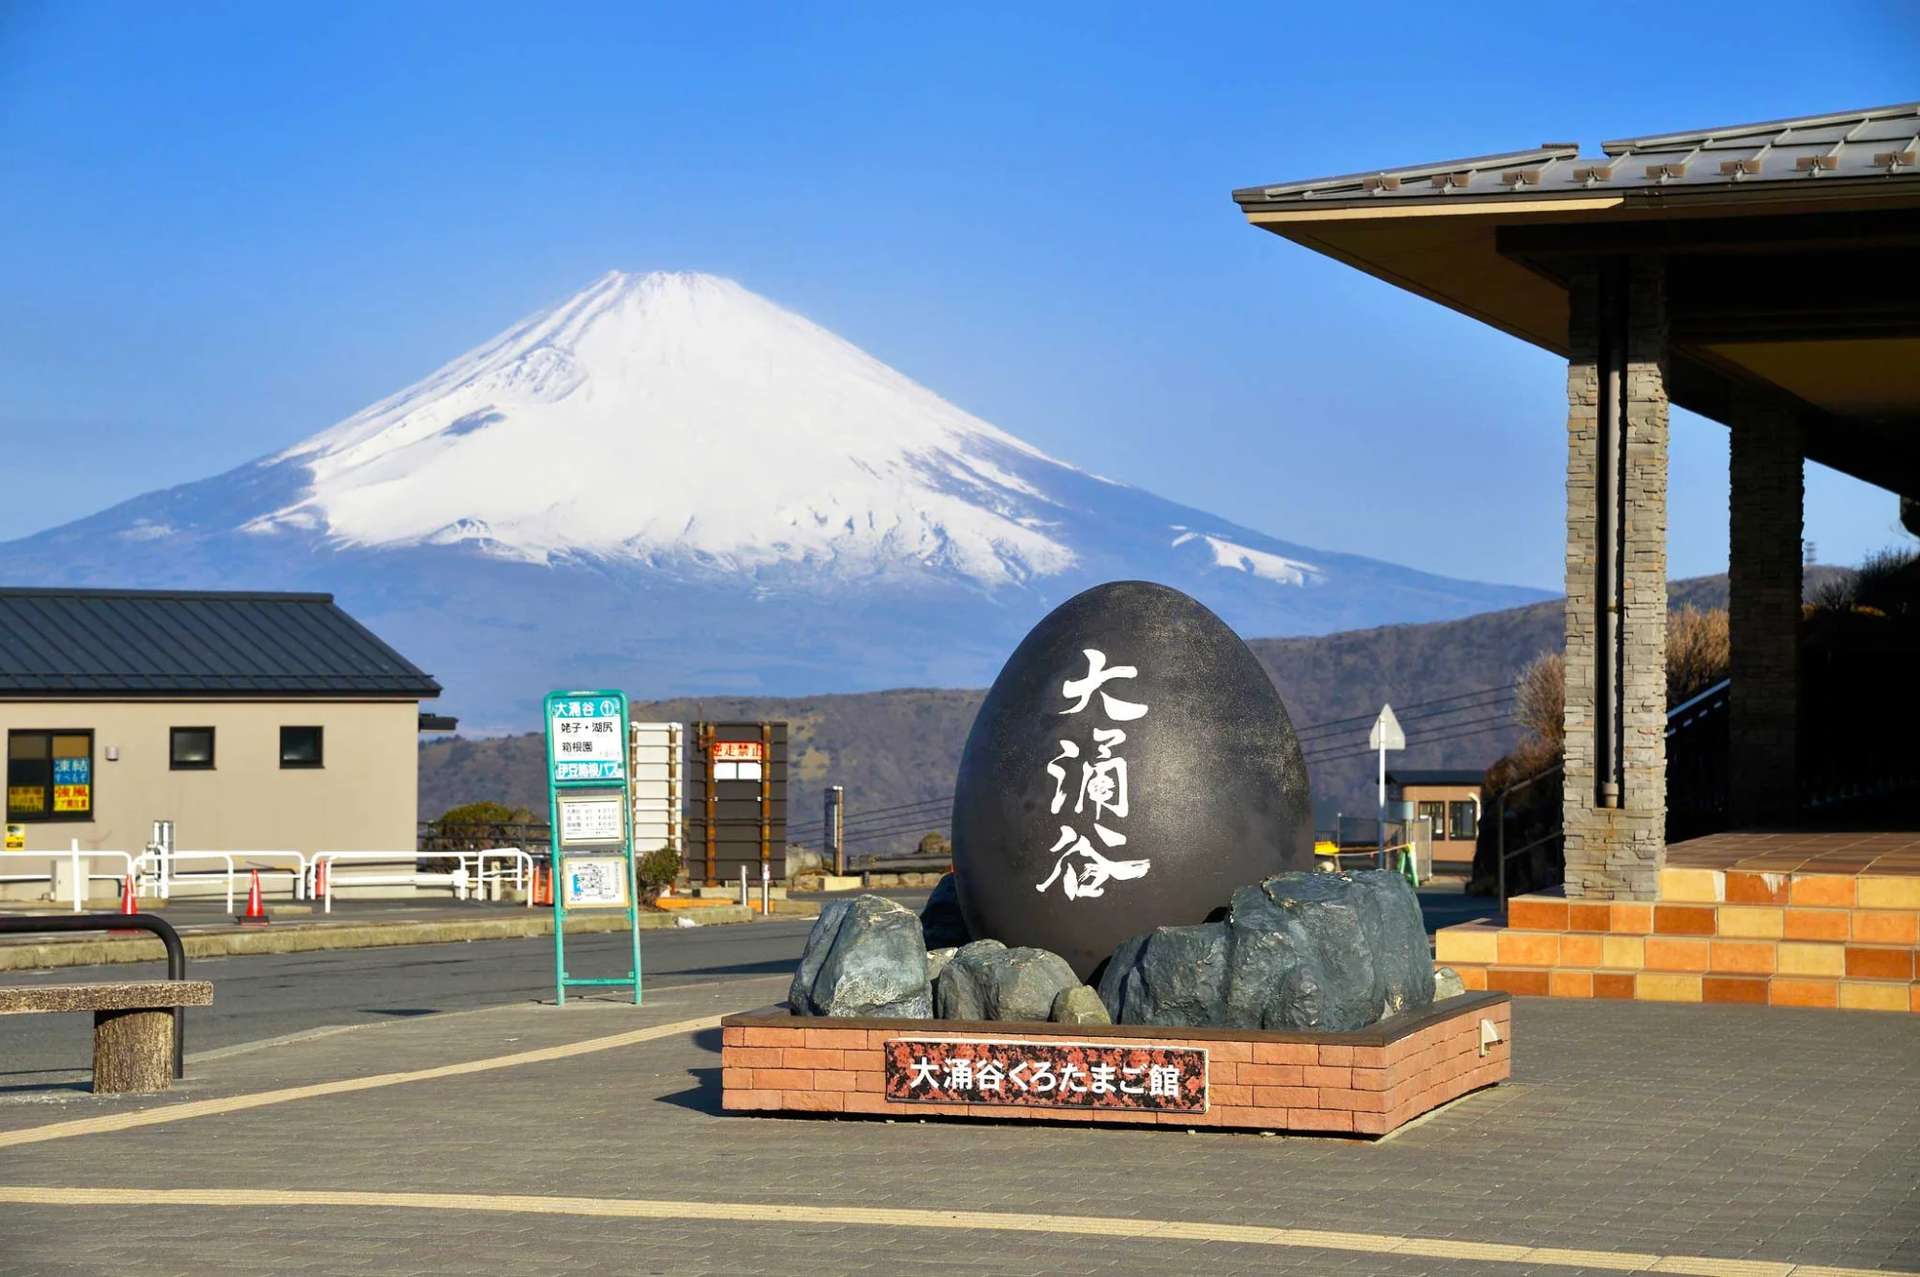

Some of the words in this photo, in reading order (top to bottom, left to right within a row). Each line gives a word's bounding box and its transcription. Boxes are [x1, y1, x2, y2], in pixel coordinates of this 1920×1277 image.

[555, 701, 595, 717] 大涌谷
[561, 721, 613, 733] 姥子・湖尻
[562, 741, 593, 753] 箱根園
[557, 762, 618, 778] 伊豆箱根バス
[1035, 649, 1151, 901] 大涌谷
[910, 1057, 1180, 1098] 大涌谷くろたまご館
